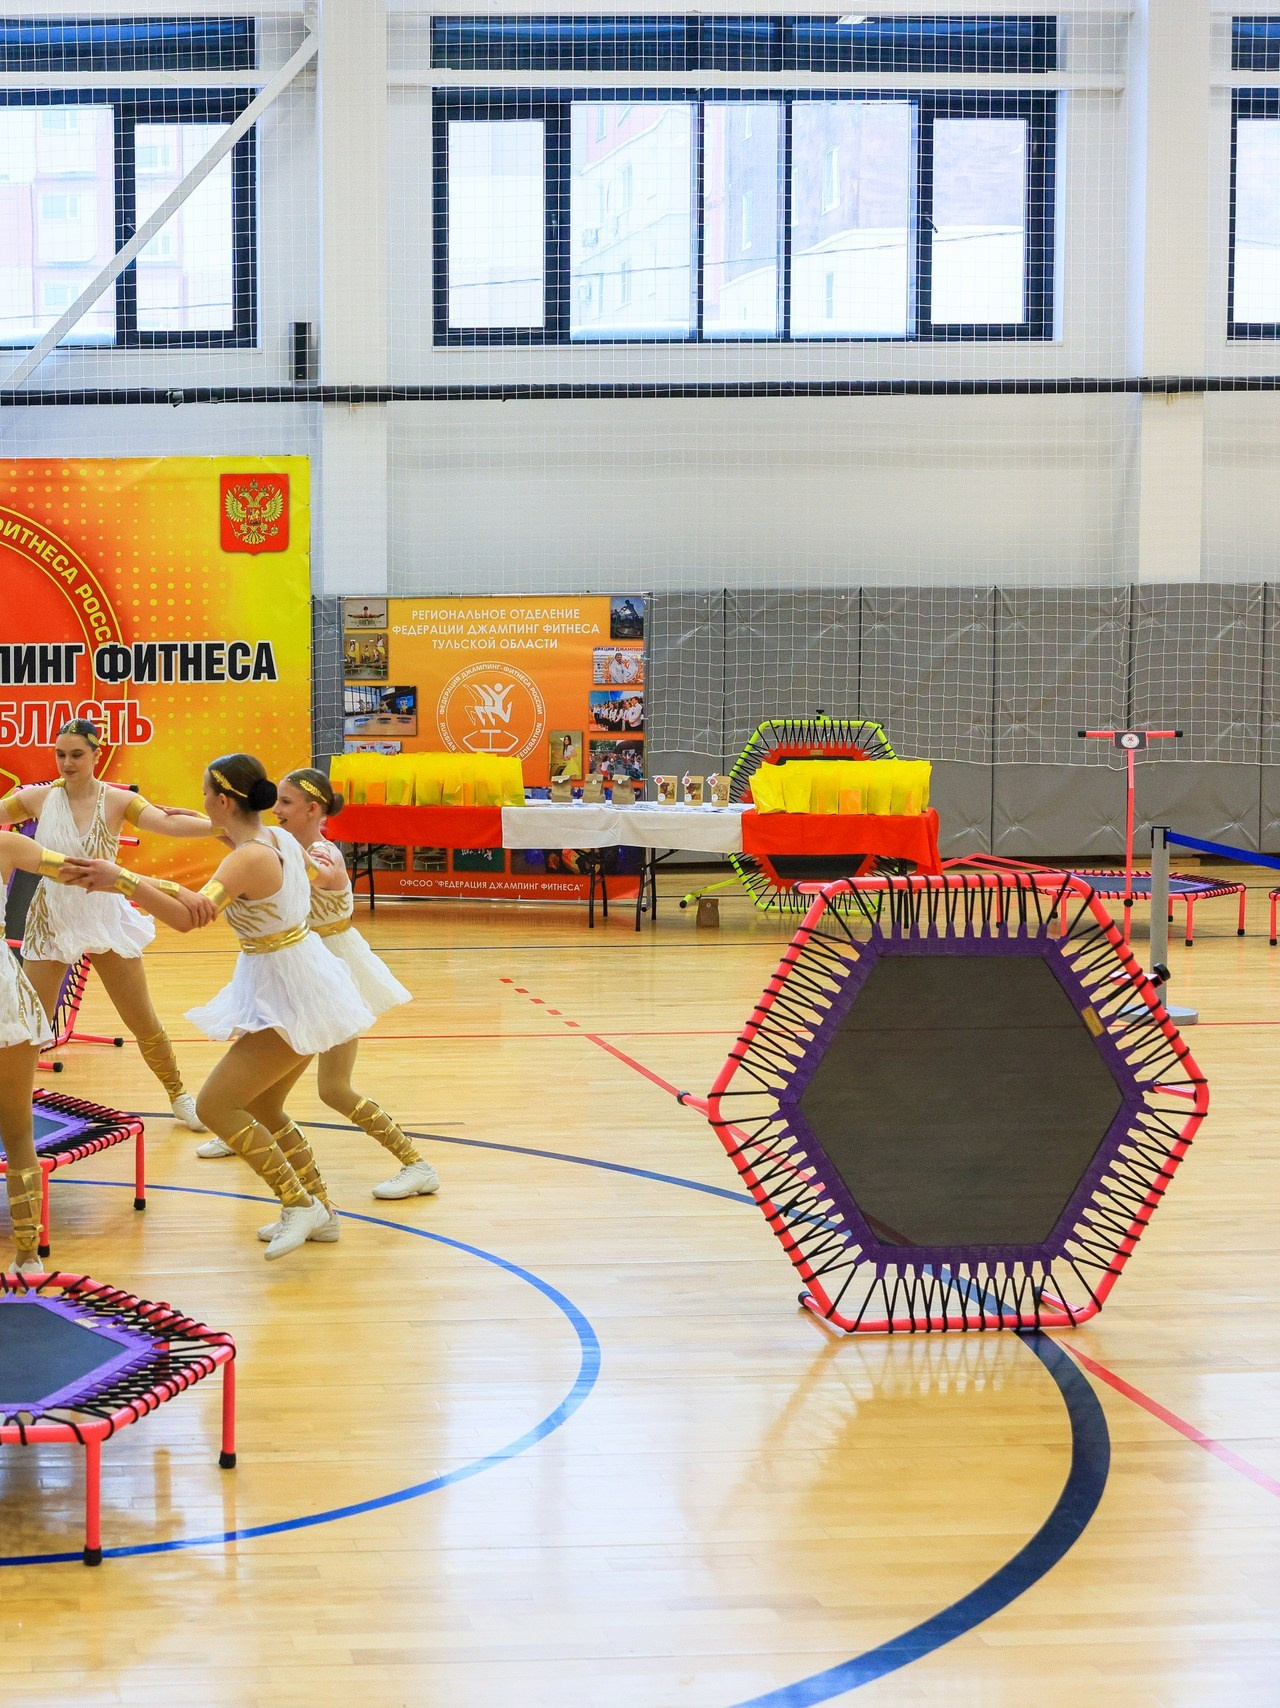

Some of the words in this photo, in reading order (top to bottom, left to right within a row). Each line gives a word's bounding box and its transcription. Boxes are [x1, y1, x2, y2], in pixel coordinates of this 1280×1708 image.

[74, 583, 112, 646] РОСС
[412, 609, 506, 620] РЕГИОНАЛЬНОЕ
[509, 608, 580, 620] ОТДЕЛЕНИЕ
[392, 624, 464, 636] ФЕДЕРАЦИИ
[467, 624, 539, 635] ДЖАМПИНГ
[542, 622, 600, 634] ФИТНЕСА
[432, 637, 496, 649] ТУЛЬСКОЙ
[499, 637, 558, 649] ОБЛАСТИ
[94, 640, 279, 685] ФИТНЕСА
[439, 676, 461, 715] ФЕДЕРАЦИЯ
[530, 687, 543, 715] РОССИИ
[439, 722, 457, 752] RUSSIAN
[399, 878, 433, 887] ОФСОО
[434, 880, 487, 890] "ФЕДЕРАЦИЯ
[489, 882, 538, 891] ДЖАМПИНГ
[540, 883, 584, 892] ФИТНЕСА"
